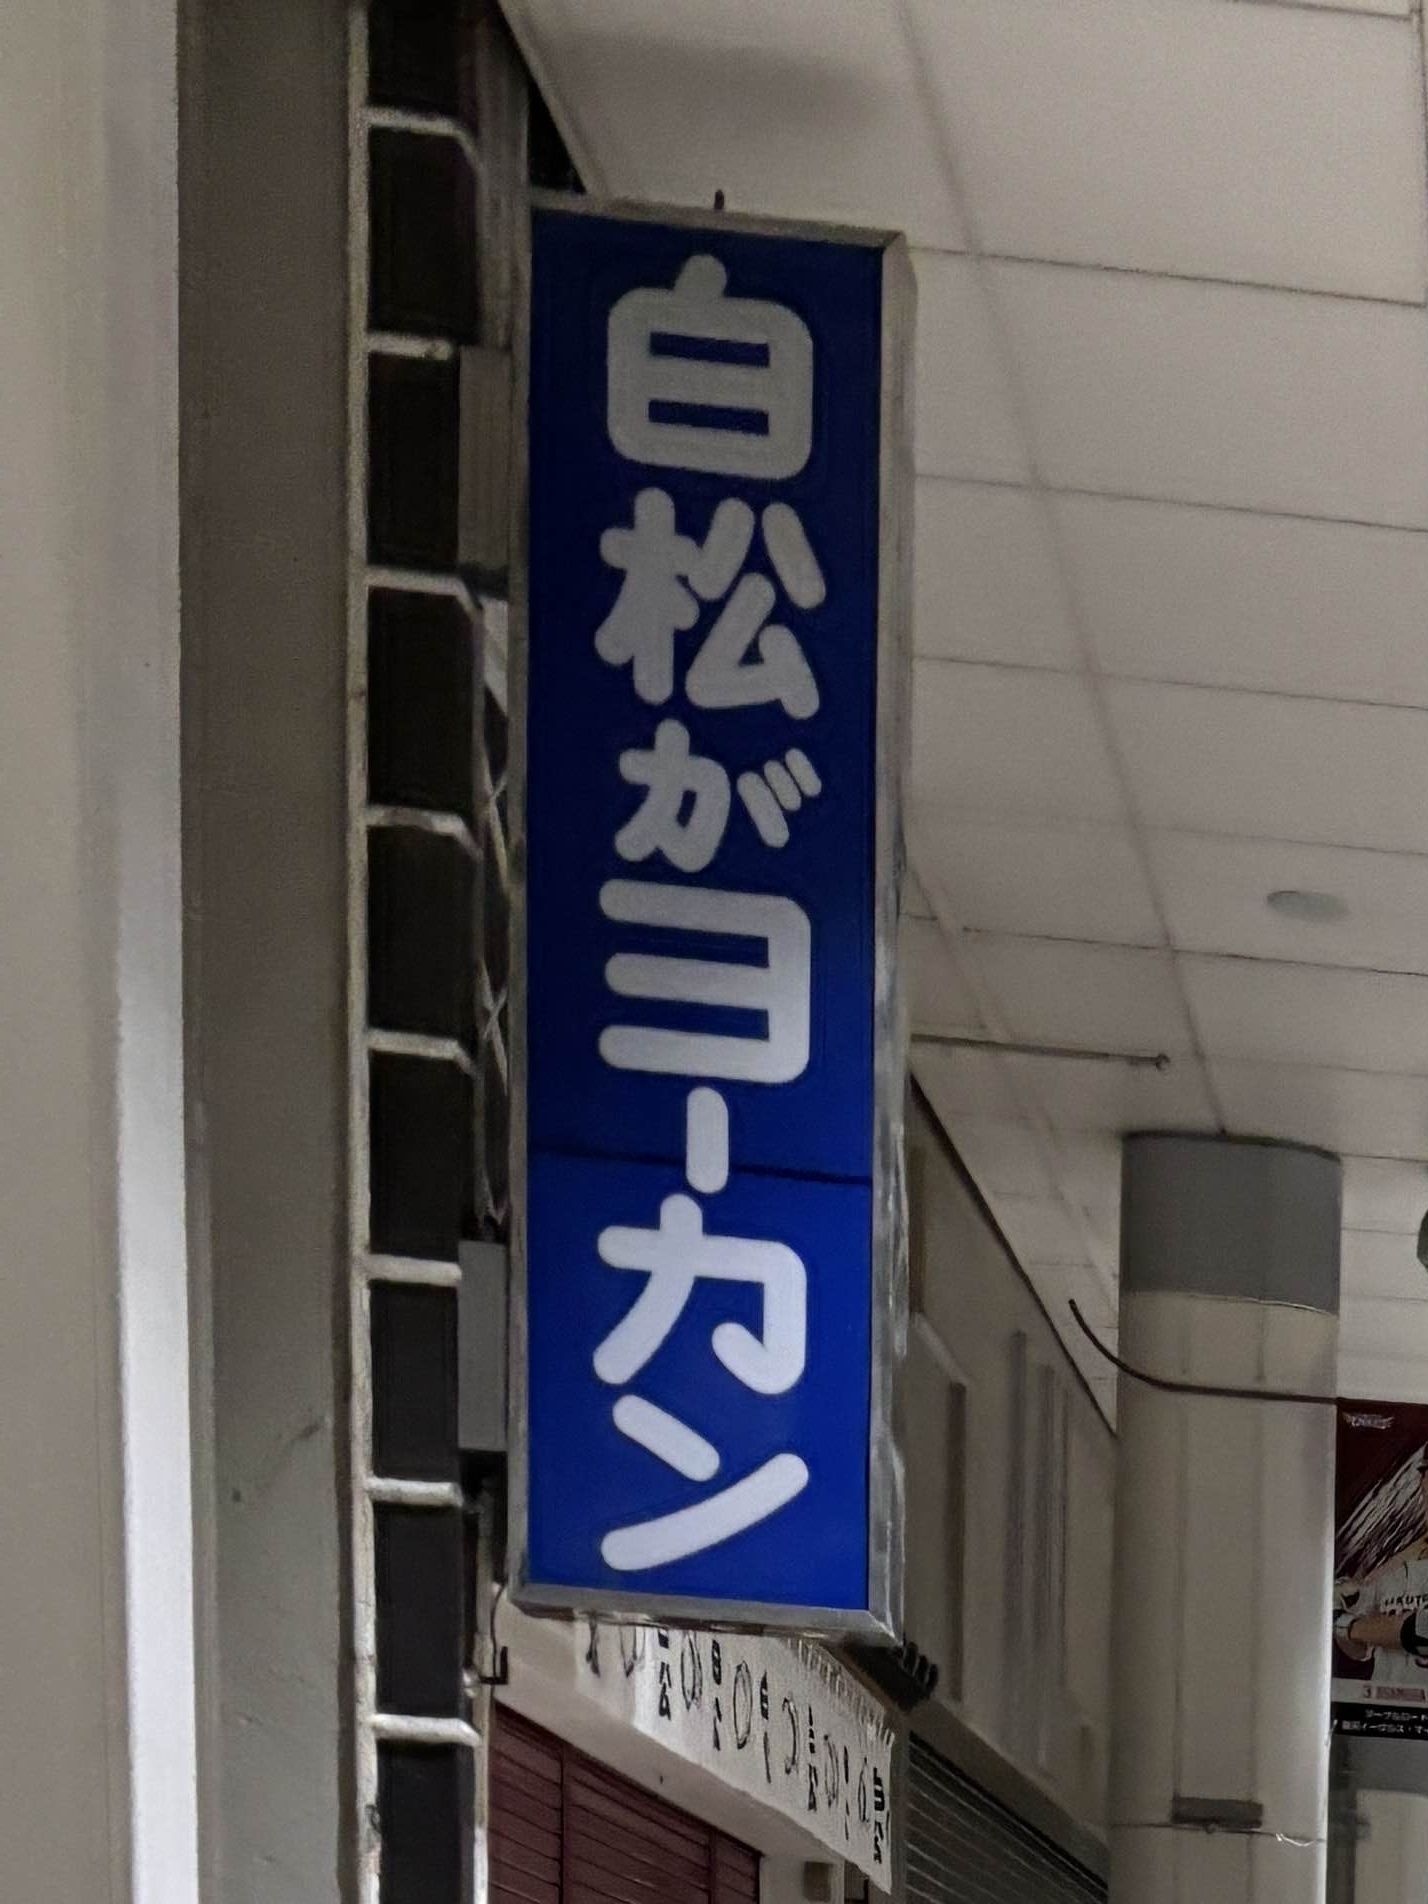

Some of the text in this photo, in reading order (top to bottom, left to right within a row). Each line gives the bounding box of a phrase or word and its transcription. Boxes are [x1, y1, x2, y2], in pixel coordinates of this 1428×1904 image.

[594, 252, 823, 1574] 白松がヨーカン
